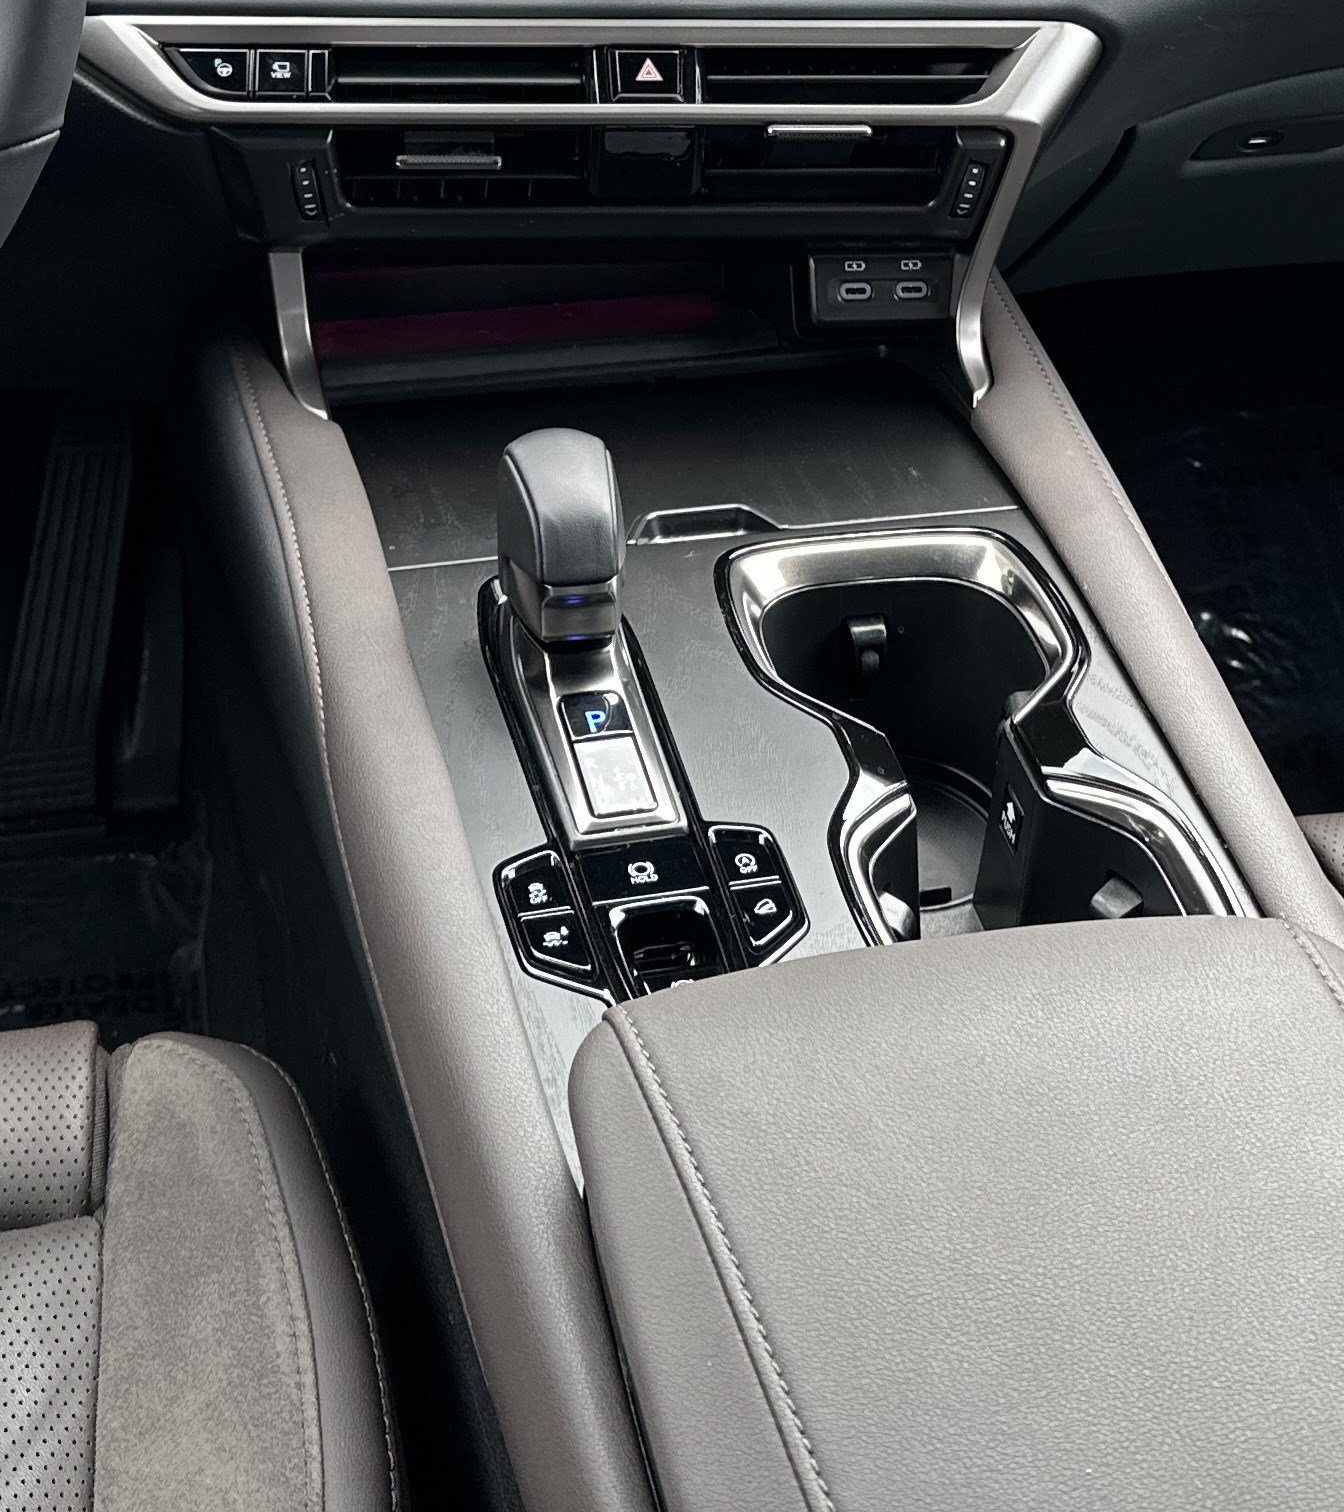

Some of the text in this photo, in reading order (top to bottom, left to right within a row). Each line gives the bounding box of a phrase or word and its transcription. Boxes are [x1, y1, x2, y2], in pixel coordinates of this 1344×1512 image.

[270, 71, 291, 79] VIEW
[585, 710, 607, 733] P
[739, 864, 759, 875] OFF
[630, 873, 659, 885] HOLD
[529, 893, 549, 905] OFF
